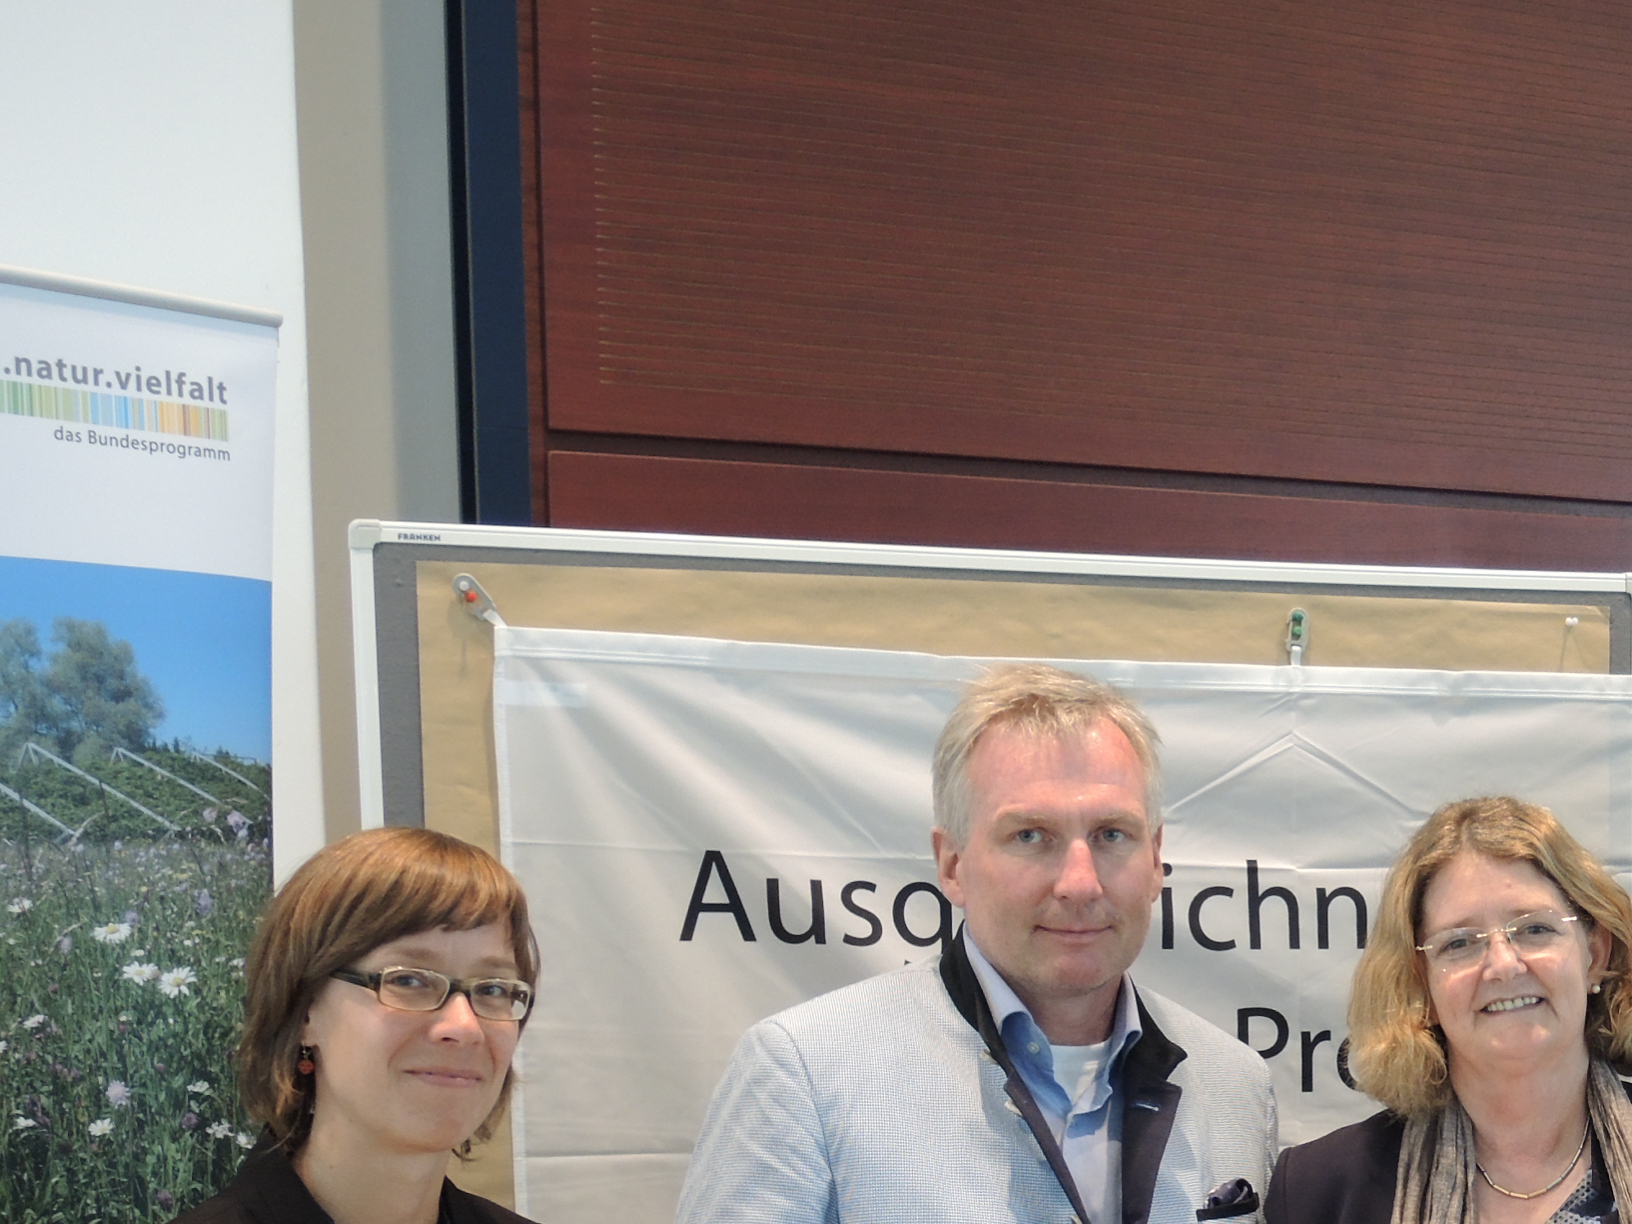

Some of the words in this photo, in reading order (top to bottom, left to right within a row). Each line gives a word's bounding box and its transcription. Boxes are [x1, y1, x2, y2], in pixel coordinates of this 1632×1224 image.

[3, 356, 228, 405] .natur.vielfalt
[54, 426, 82, 443] das
[88, 429, 231, 461] Bundesprogramm
[397, 533, 441, 541] FRANKEN
